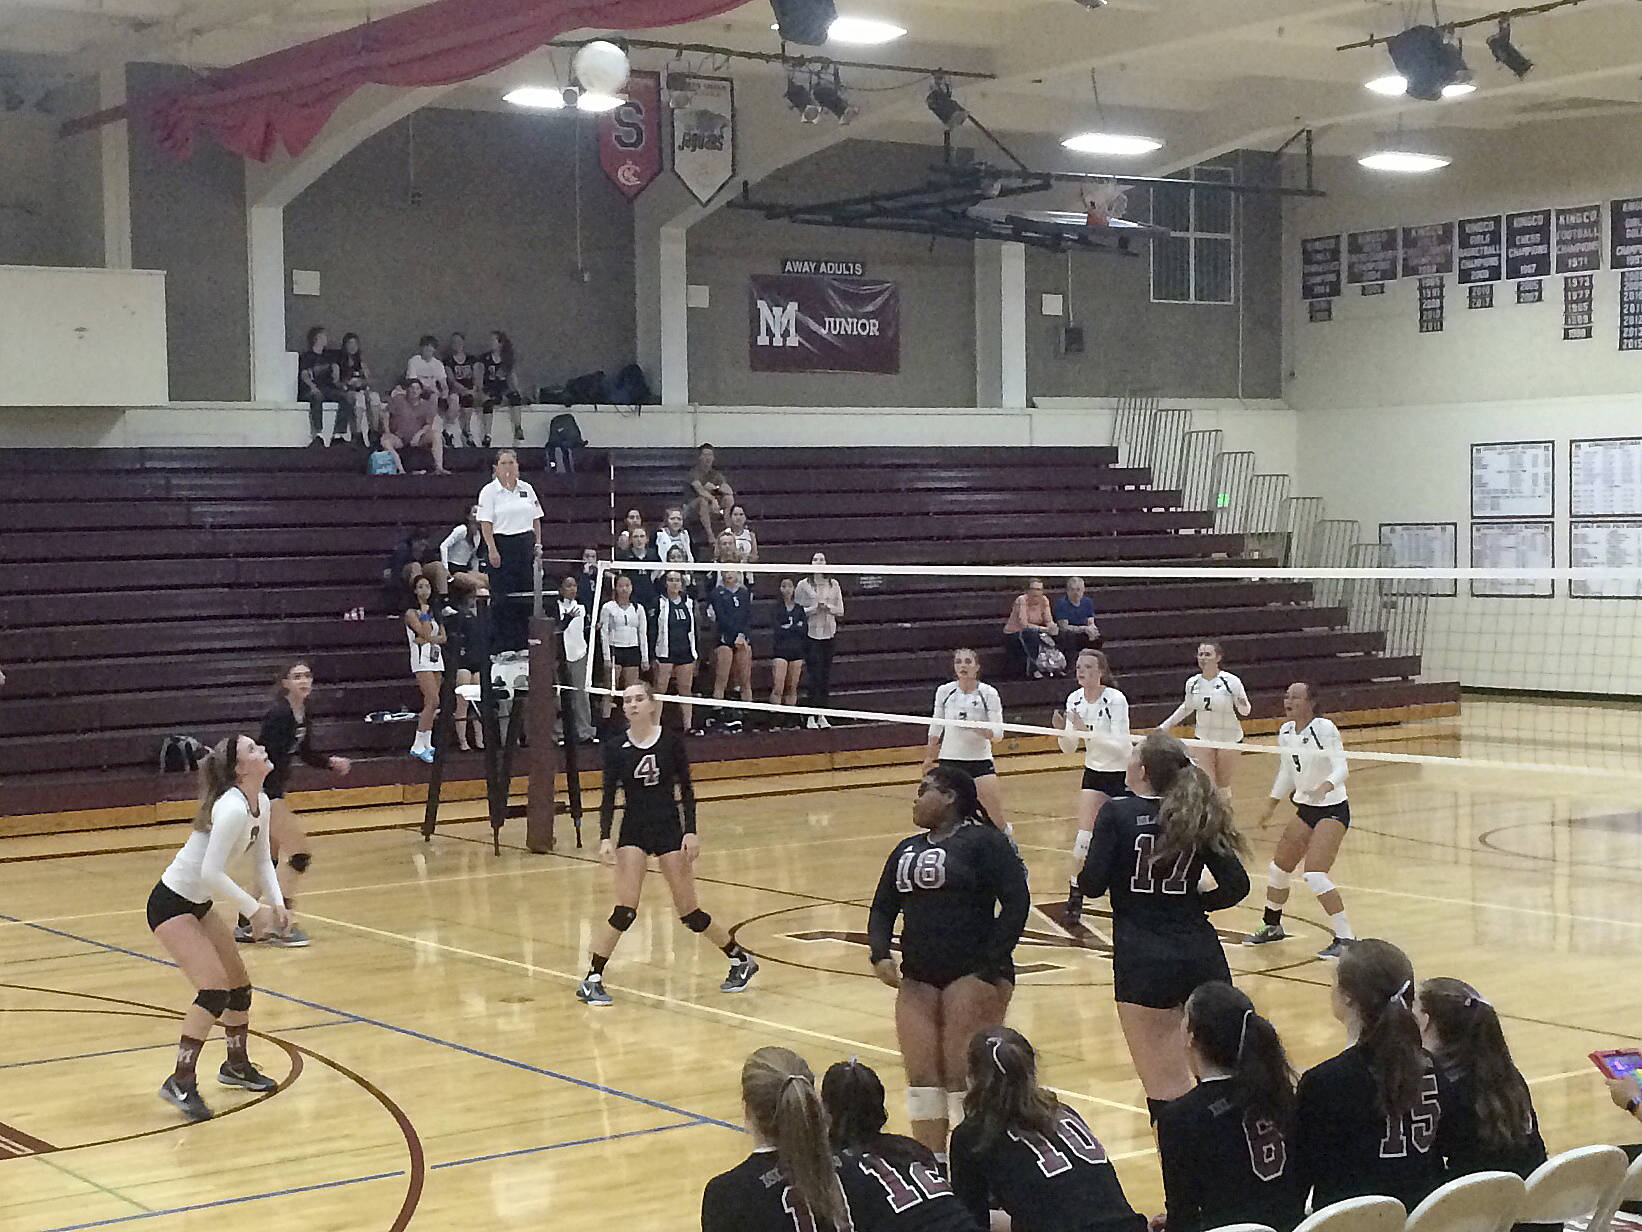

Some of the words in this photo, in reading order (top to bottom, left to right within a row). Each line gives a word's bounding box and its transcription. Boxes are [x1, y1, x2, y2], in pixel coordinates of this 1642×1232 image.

[613, 101, 645, 149] S
[784, 261, 816, 273] AWAY
[820, 262, 863, 275] ADULTS
[1568, 257, 1589, 268] 1971
[824, 317, 880, 336] JUNIOR
[1203, 696, 1213, 712] 2
[633, 754, 661, 787] 4
[896, 847, 947, 893] 18
[1379, 1073, 1442, 1159] 15
[1006, 1109, 1108, 1178] 10
